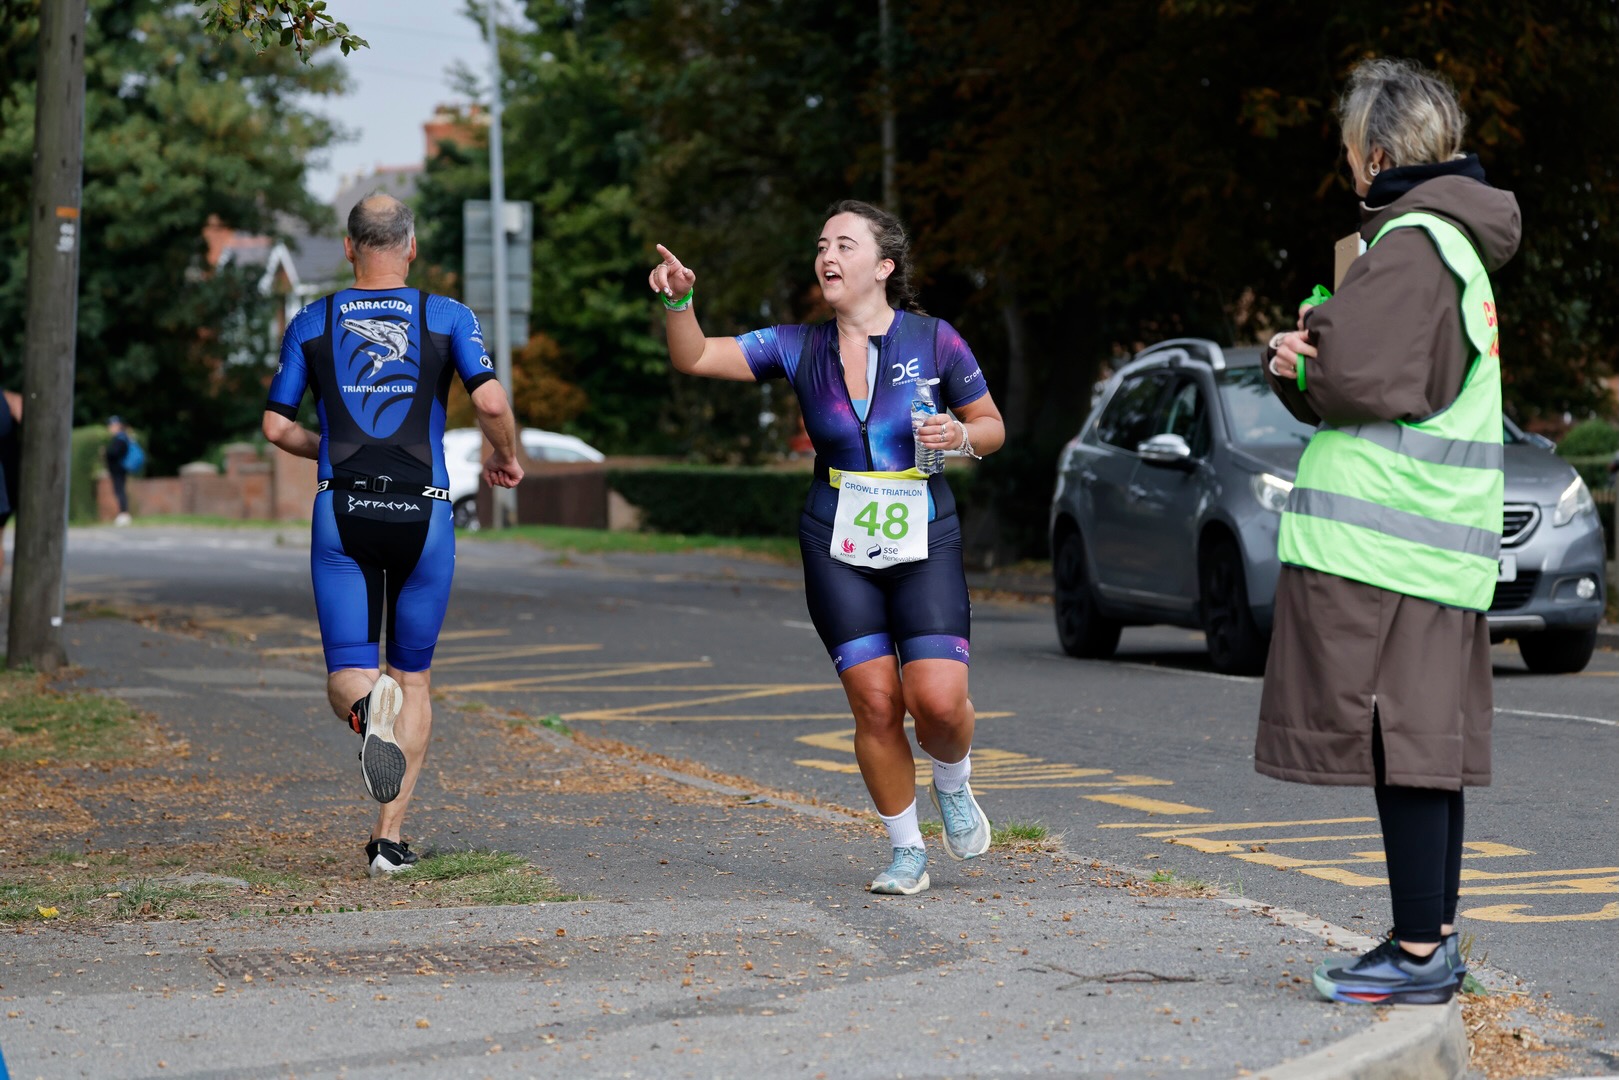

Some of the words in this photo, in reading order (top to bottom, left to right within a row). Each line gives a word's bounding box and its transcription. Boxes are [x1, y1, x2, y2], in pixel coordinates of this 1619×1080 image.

[340, 300, 413, 315] BARRACUDA
[342, 385, 390, 393] TRIATHLON
[391, 385, 413, 393] CLUB
[844, 481, 879, 495] CROWLE
[881, 488, 923, 497] TRIATHLON
[853, 500, 909, 541] 48
